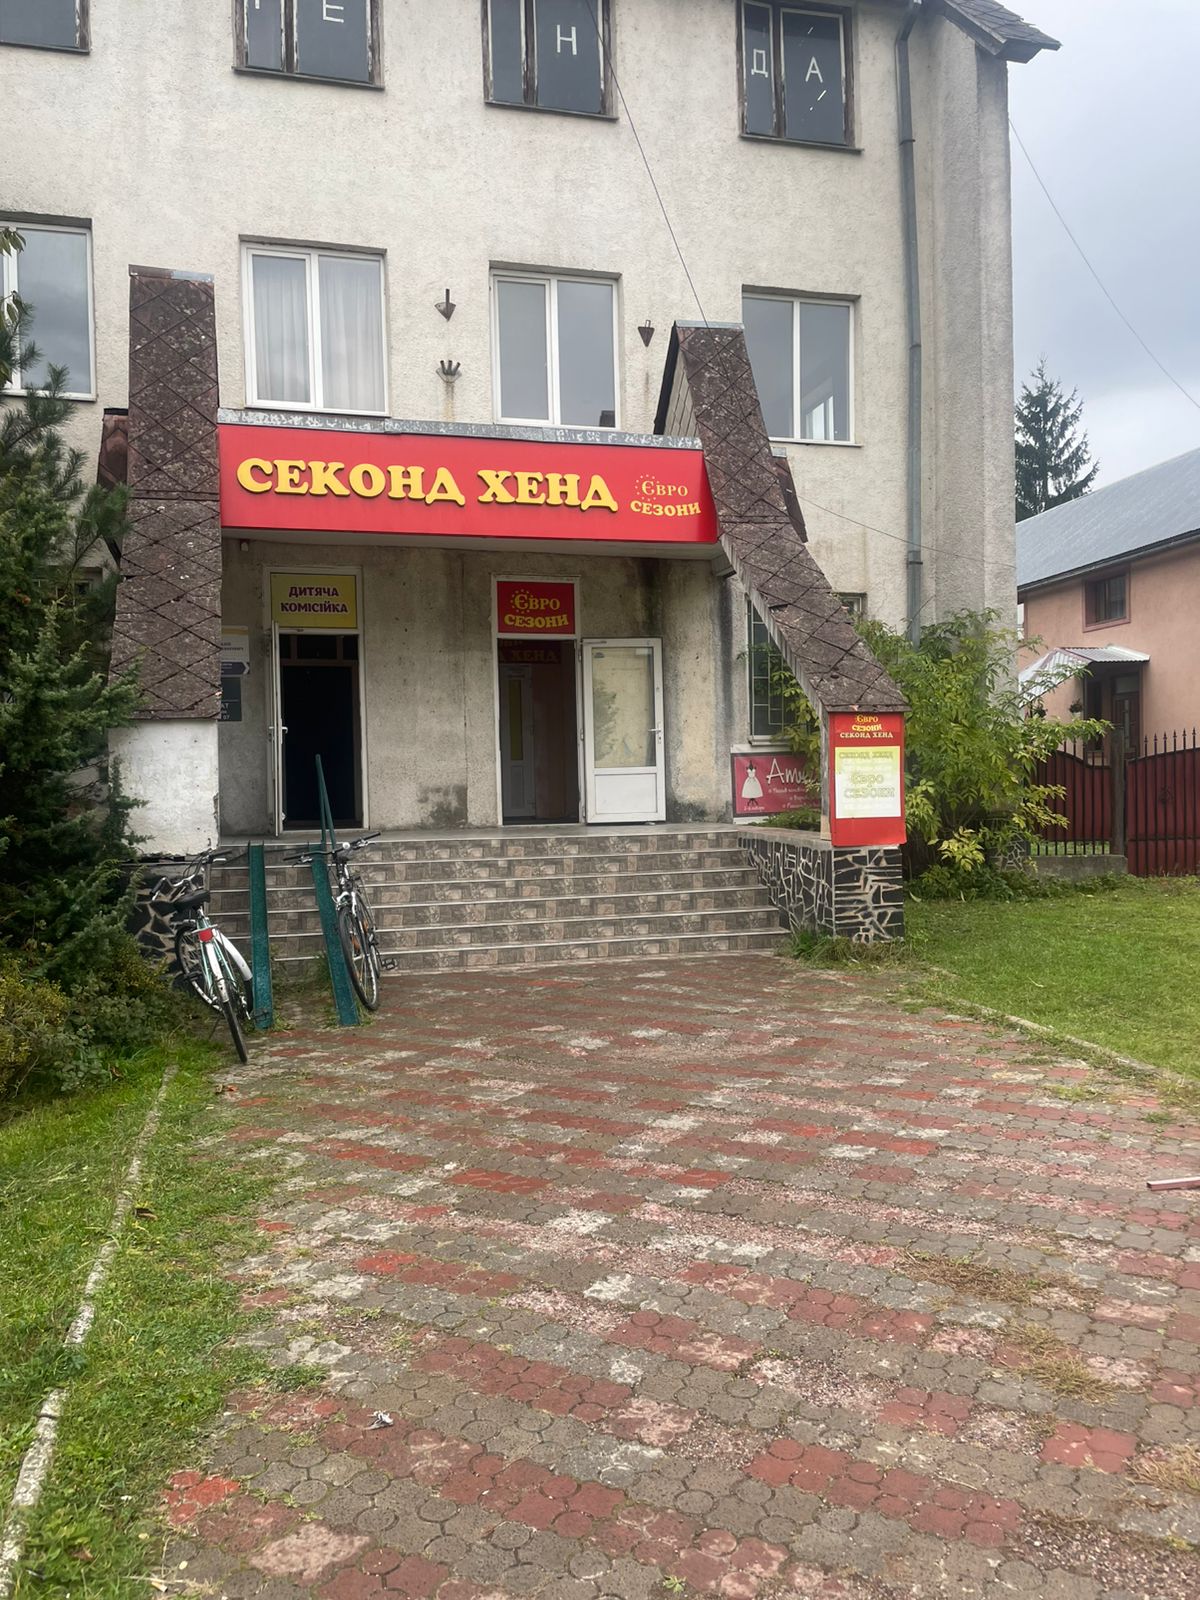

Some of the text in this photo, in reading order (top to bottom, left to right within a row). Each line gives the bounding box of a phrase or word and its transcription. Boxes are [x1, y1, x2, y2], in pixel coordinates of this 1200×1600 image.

[236, 457, 619, 513] СЕКОНД ХЕНД
[630, 500, 702, 517] СЕЗОНИ
[288, 586, 340, 598] ДИТЯЧА
[280, 600, 349, 613] КОМІСІЙКА
[503, 613, 569, 628] СЕЗОНИ
[851, 723, 883, 732] СЕЗОНИ
[839, 731, 894, 739] СЕКОНД ХЕНД
